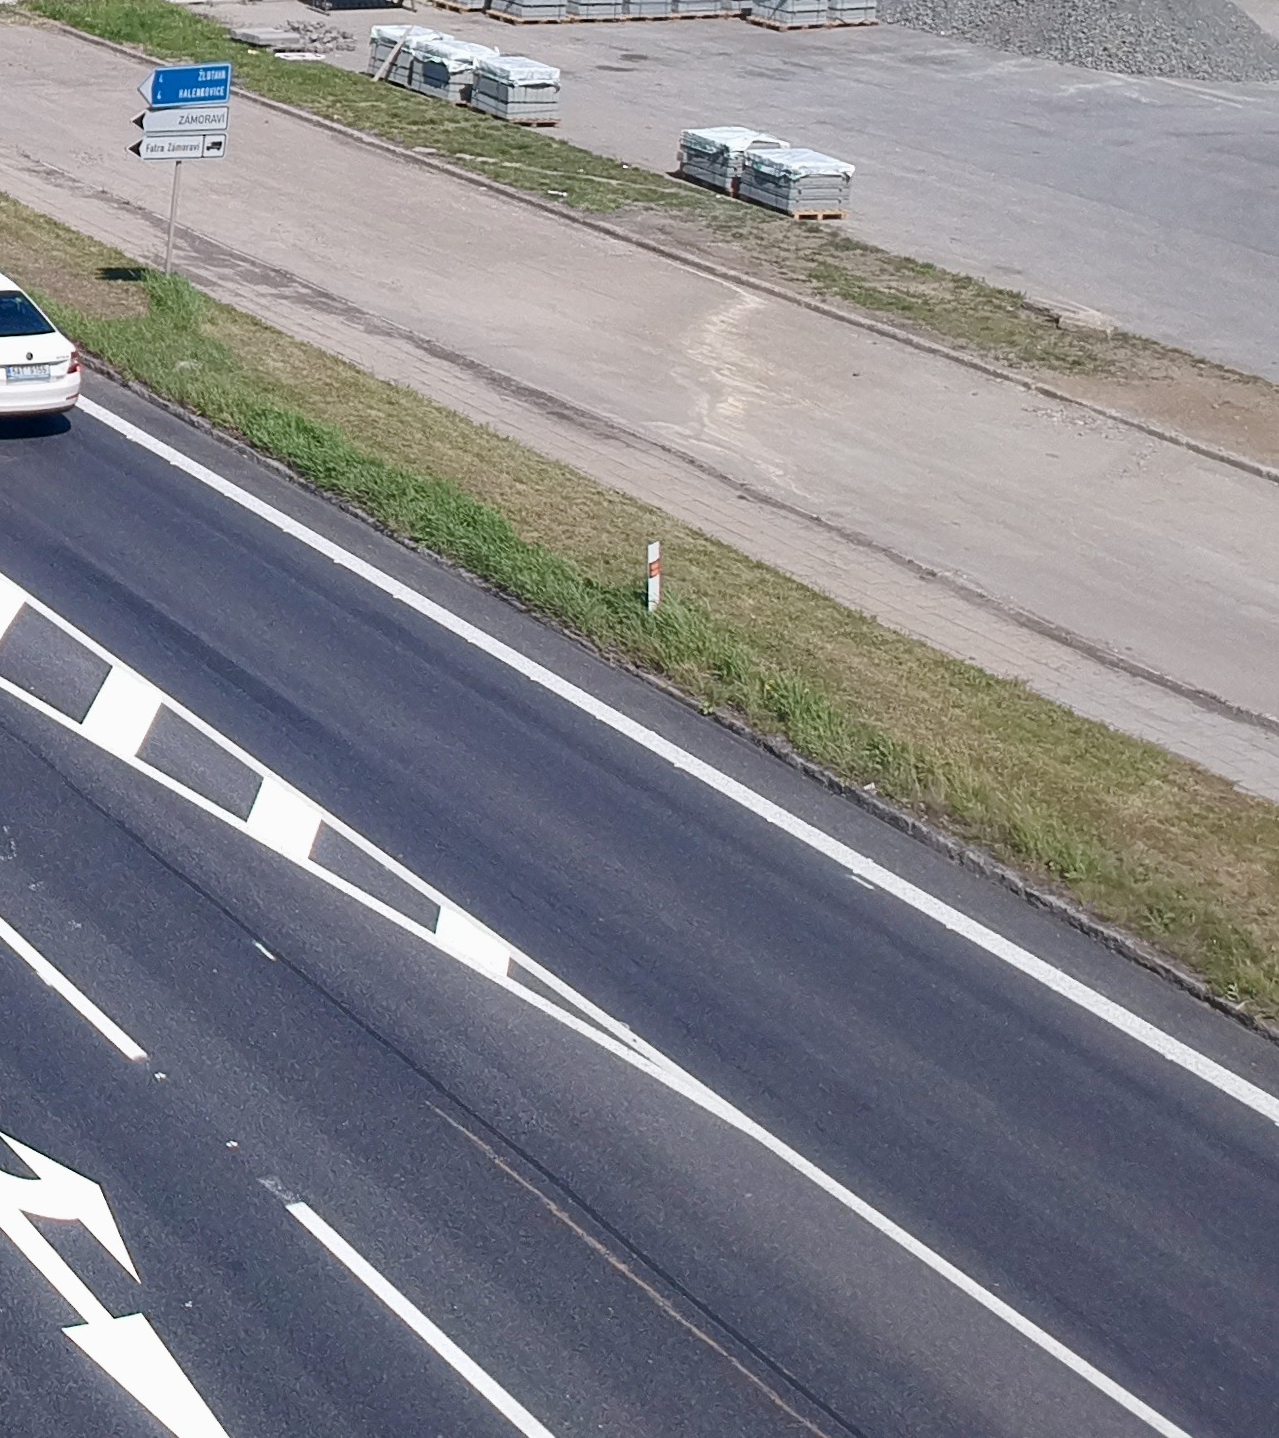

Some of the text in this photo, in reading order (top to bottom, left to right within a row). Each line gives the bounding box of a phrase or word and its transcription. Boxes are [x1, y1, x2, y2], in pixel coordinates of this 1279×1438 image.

[178, 112, 225, 125] ZÁMORAVÍ
[145, 141, 200, 153] Fatra Zámoraví
